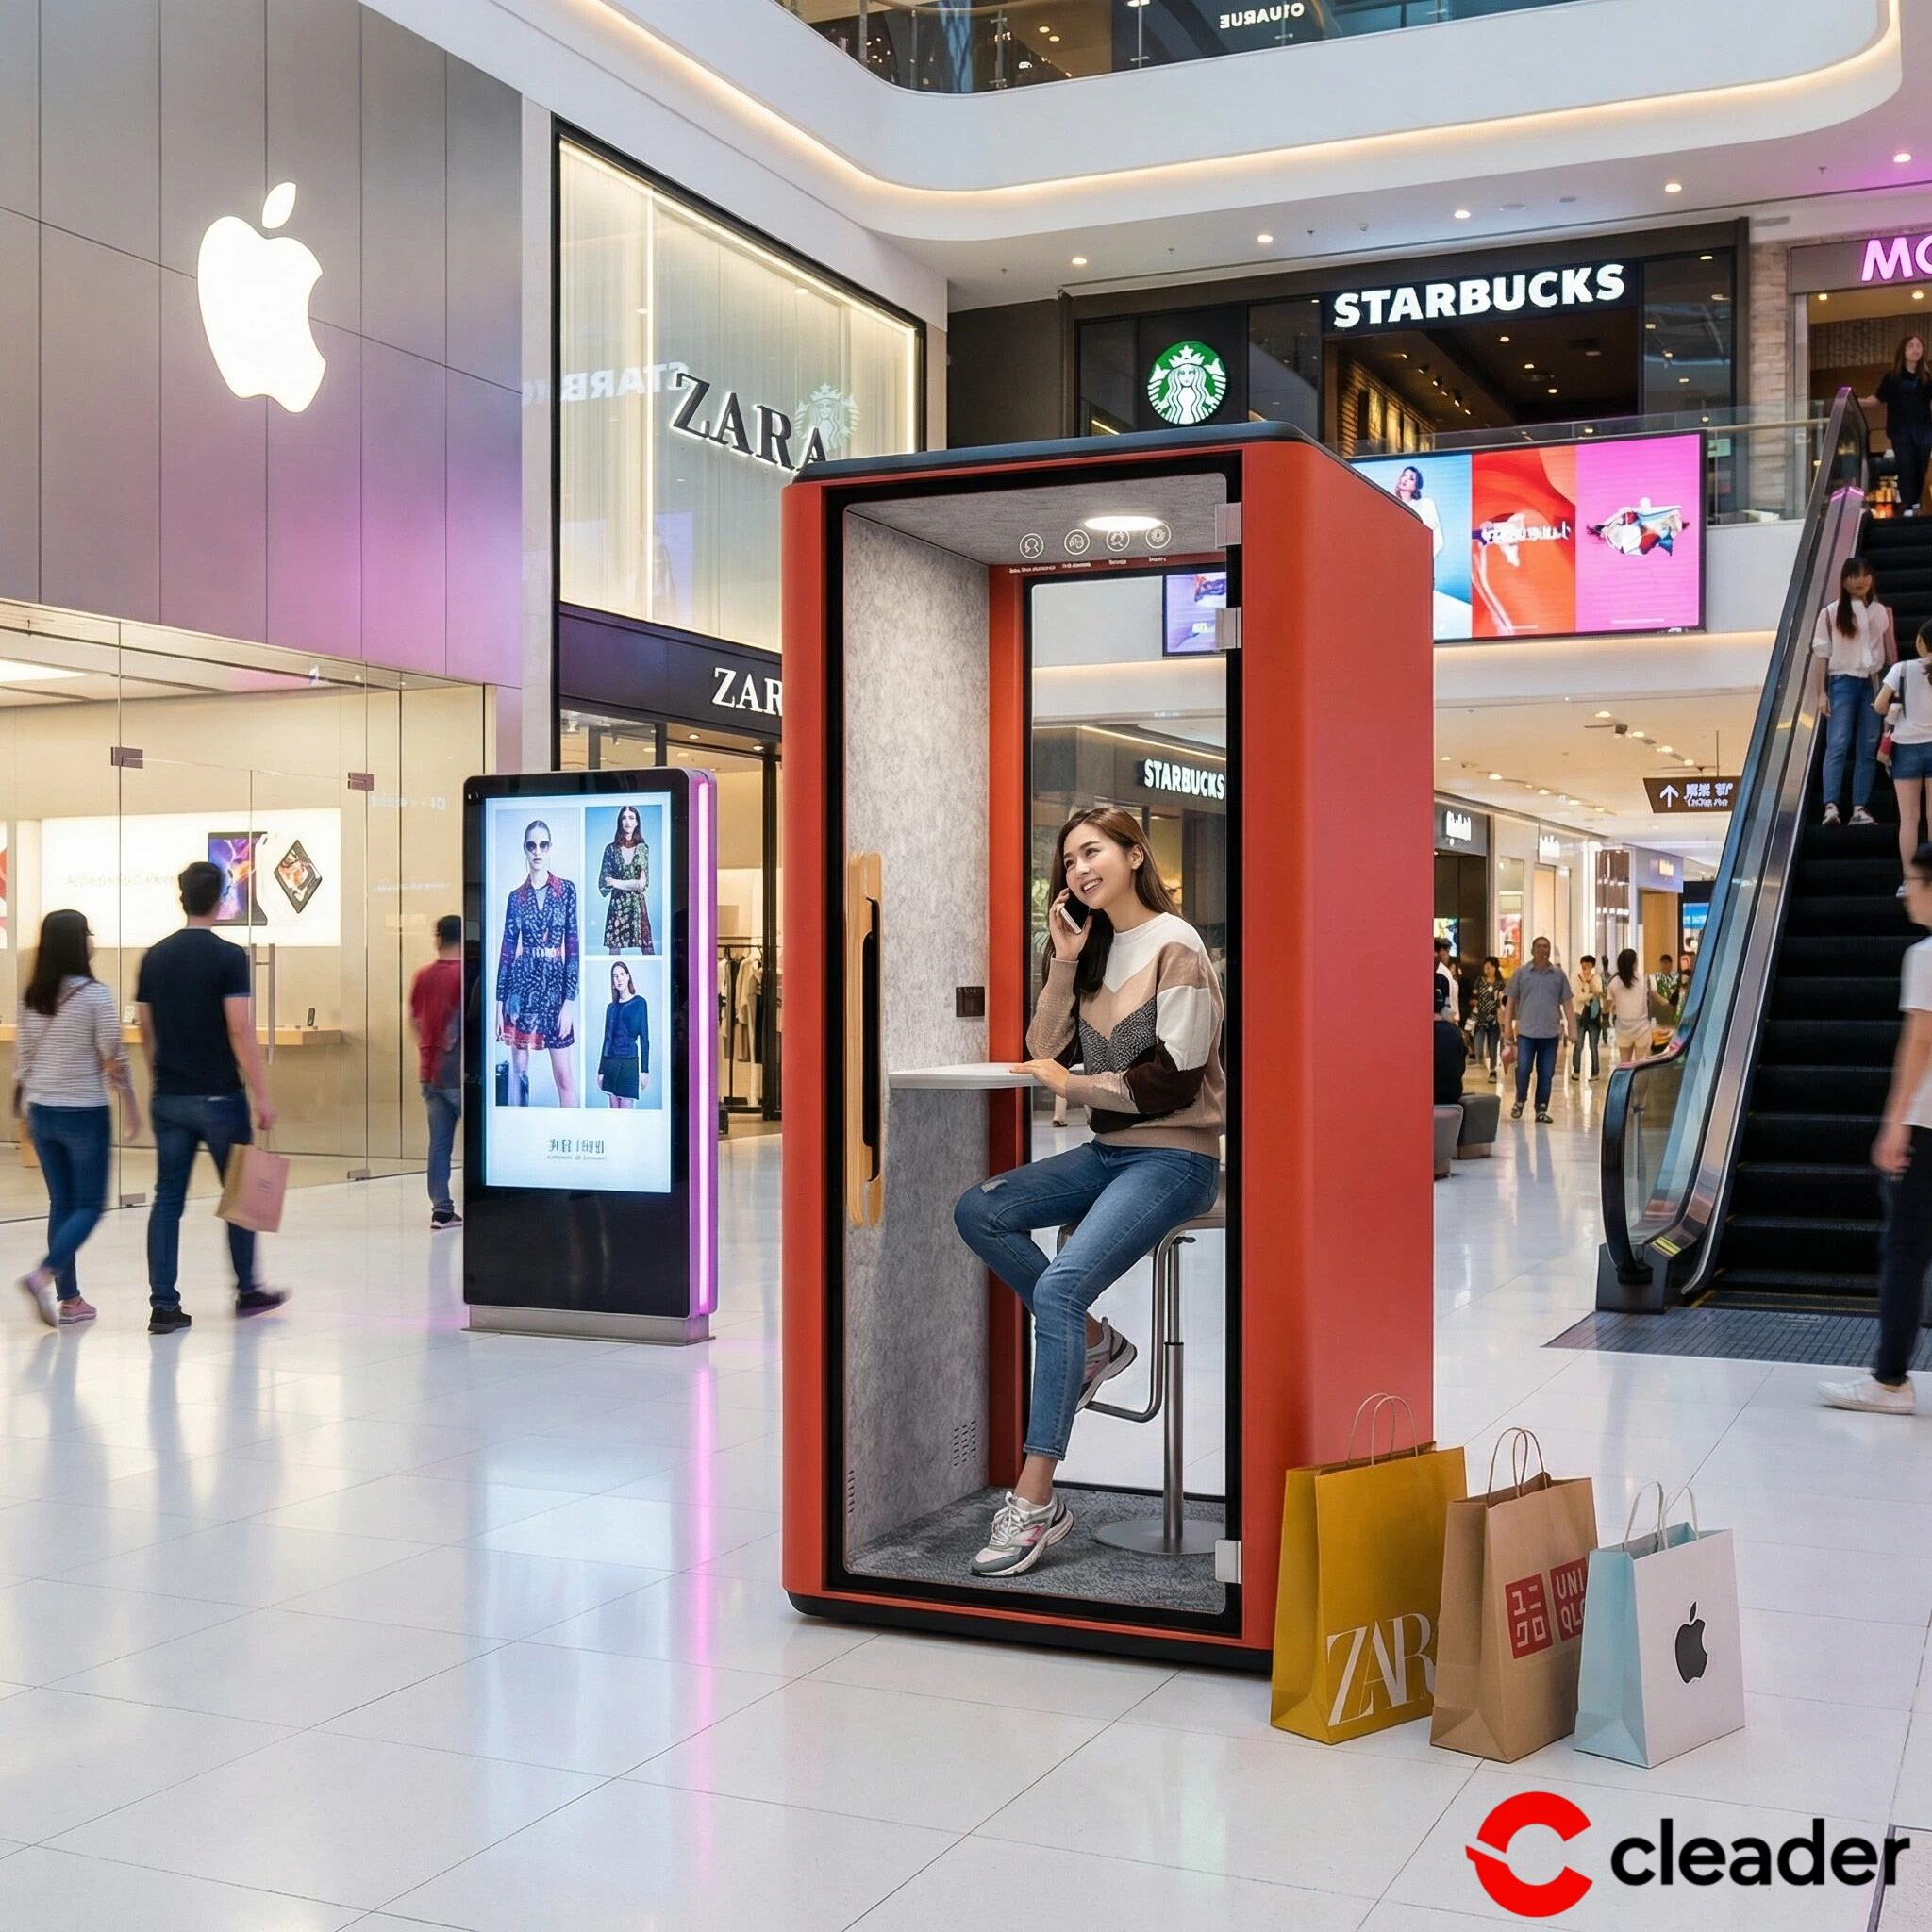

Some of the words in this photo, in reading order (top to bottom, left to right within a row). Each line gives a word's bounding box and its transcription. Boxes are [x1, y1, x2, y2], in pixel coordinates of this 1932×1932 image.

[1334, 264, 1625, 328] STARBUCKS
[672, 371, 827, 473] ZARA
[712, 667, 783, 717] ZAR
[1143, 758, 1225, 801] STARBUCKS
[1556, 1567, 1585, 1601] UNI
